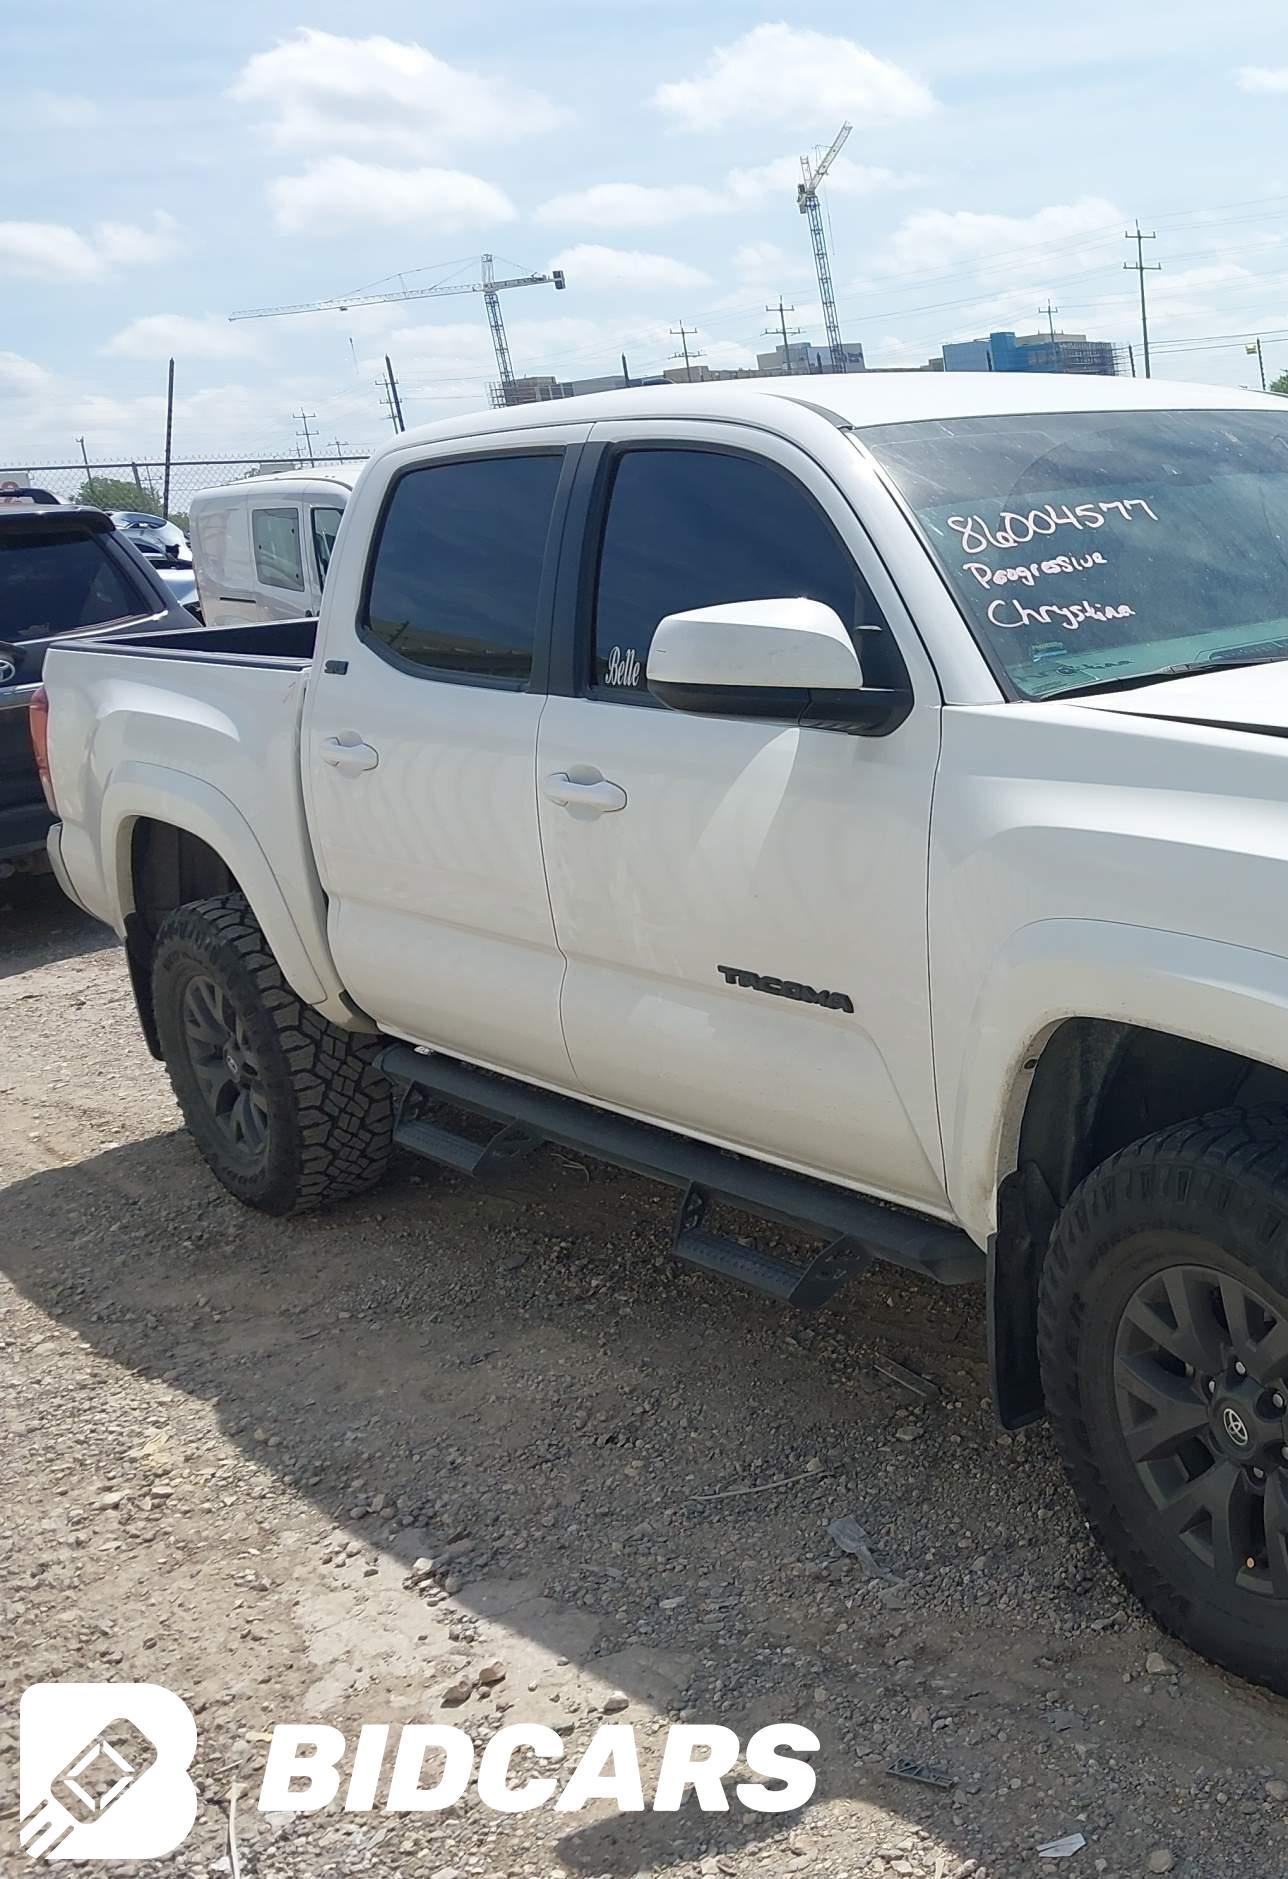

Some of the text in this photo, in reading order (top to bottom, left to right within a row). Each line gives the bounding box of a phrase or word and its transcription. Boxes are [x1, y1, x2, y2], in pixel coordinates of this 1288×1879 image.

[947, 500, 1159, 553] 86004577
[605, 646, 641, 686] Belle
[717, 964, 854, 1014] TACOMA
